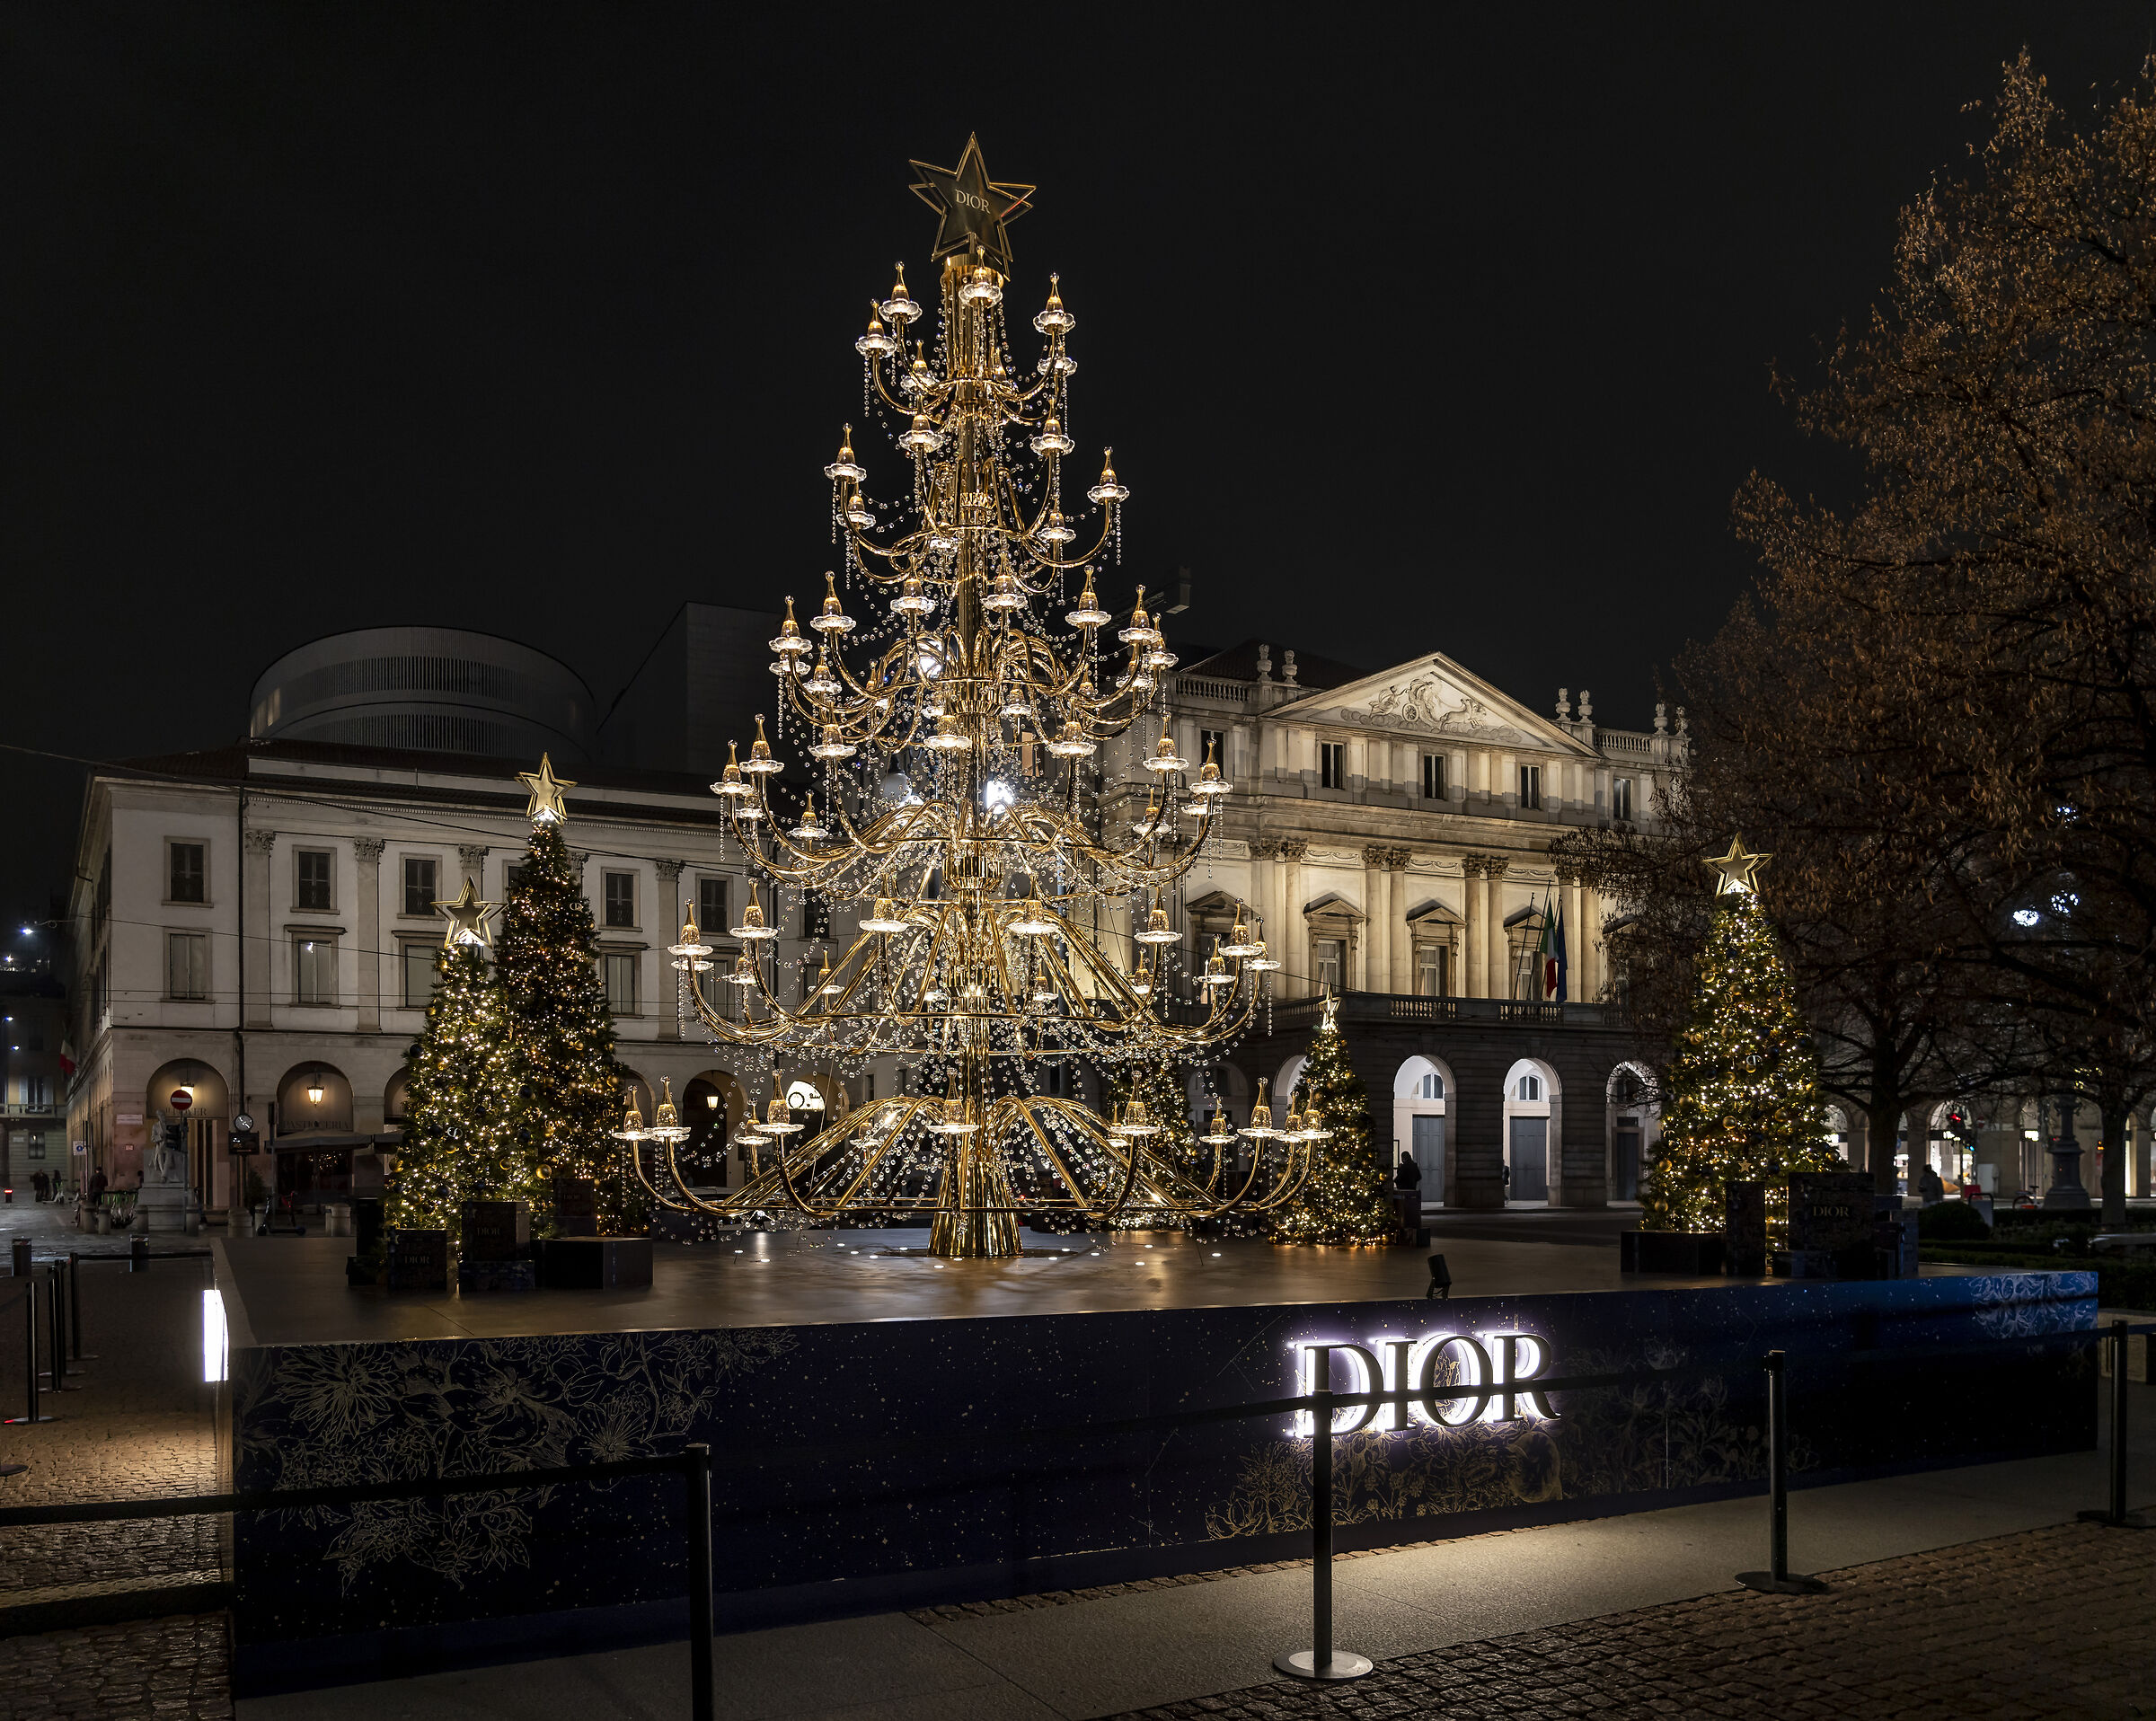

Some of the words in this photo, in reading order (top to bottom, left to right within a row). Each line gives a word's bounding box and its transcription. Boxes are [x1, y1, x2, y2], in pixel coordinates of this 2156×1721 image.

[955, 189, 991, 214] DIOR
[1812, 1205, 1851, 1217] DIOR
[403, 1254, 430, 1265] DIOR
[1294, 1333, 1561, 1438] DIOR
